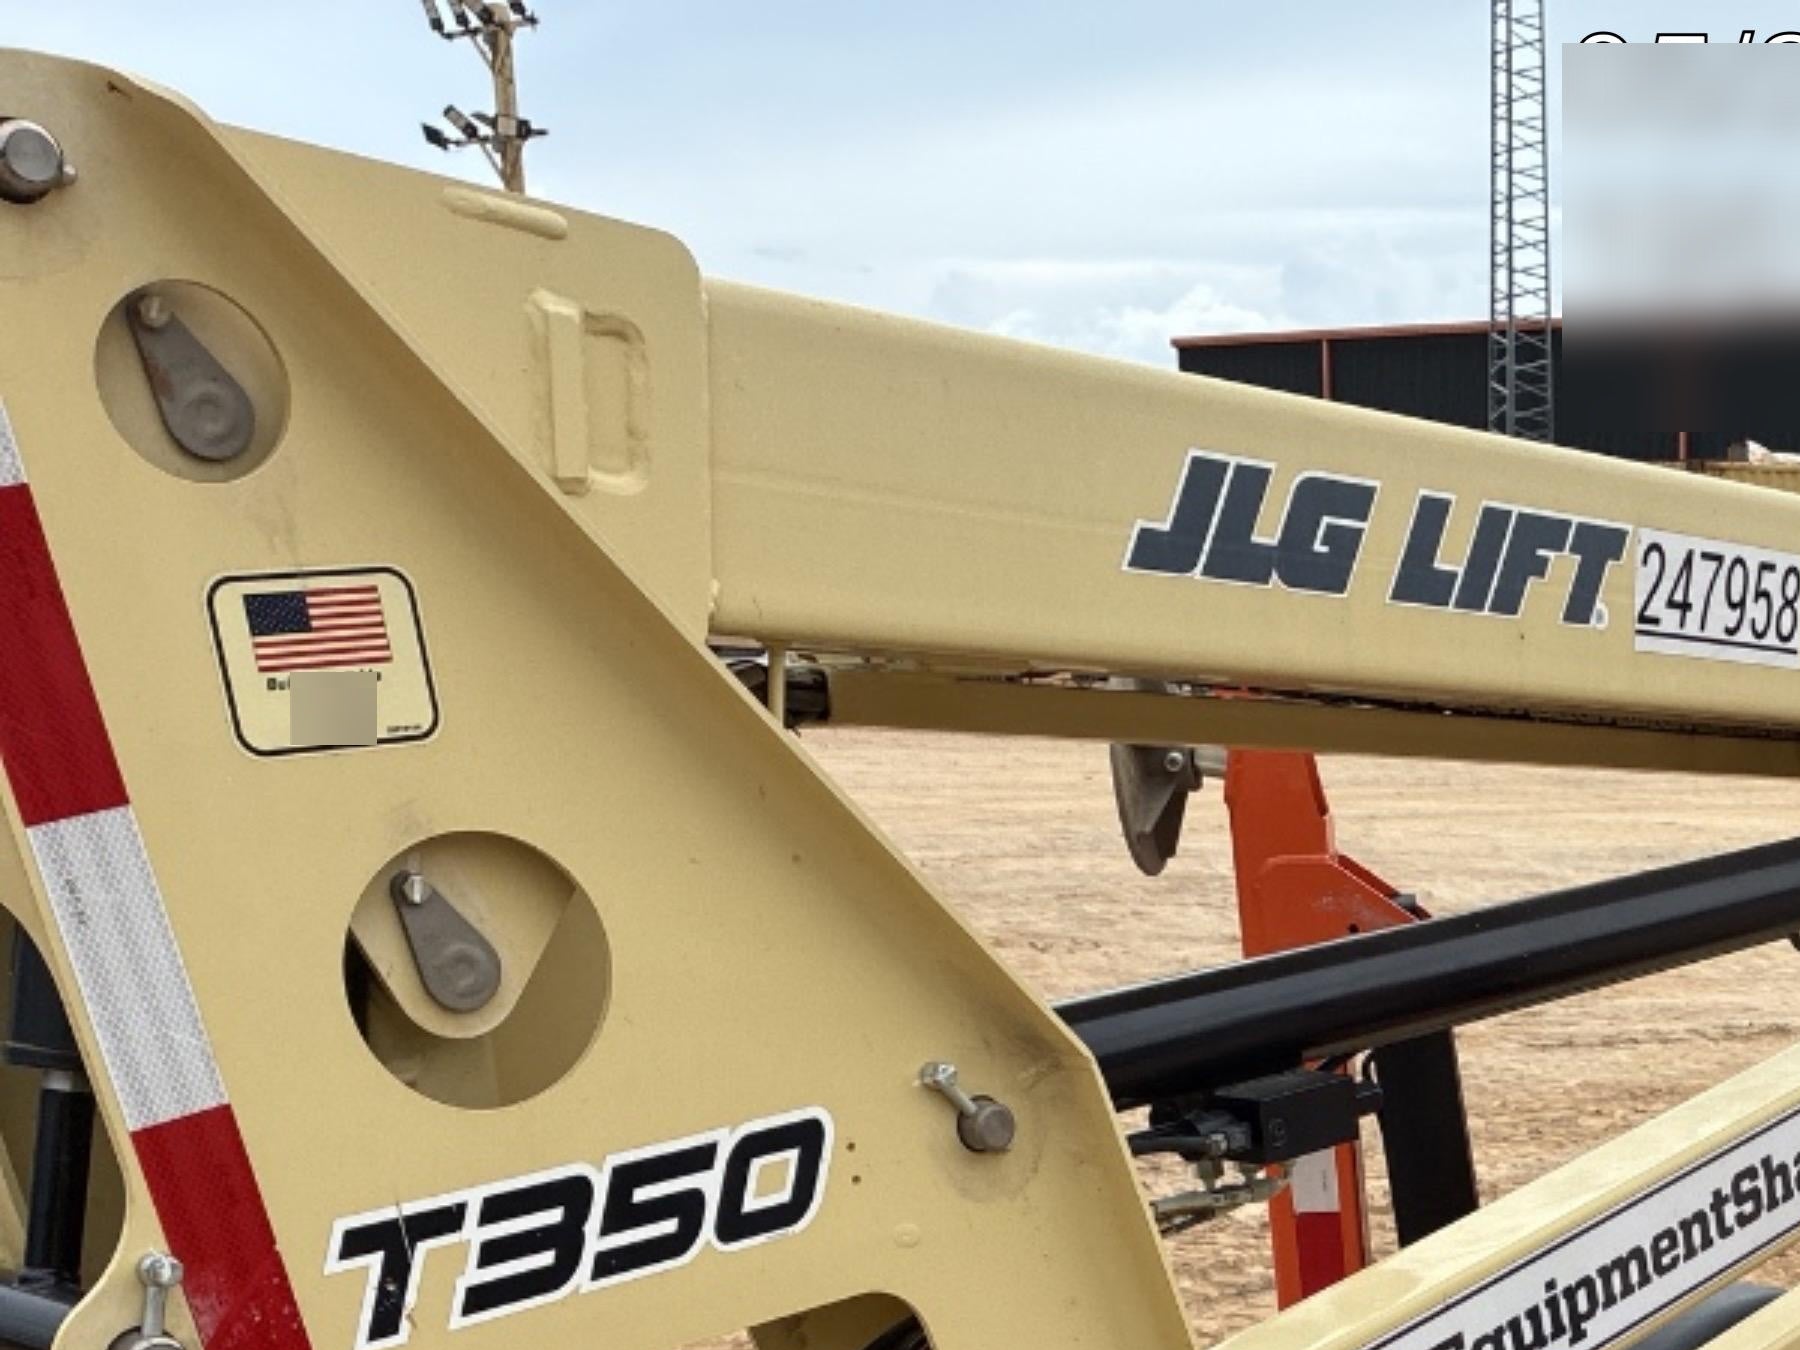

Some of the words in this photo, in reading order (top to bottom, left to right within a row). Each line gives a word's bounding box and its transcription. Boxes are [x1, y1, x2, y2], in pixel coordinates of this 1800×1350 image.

[1126, 451, 1379, 595] JLG
[1390, 491, 1631, 626] LIFT
[334, 1113, 828, 1347] T350
